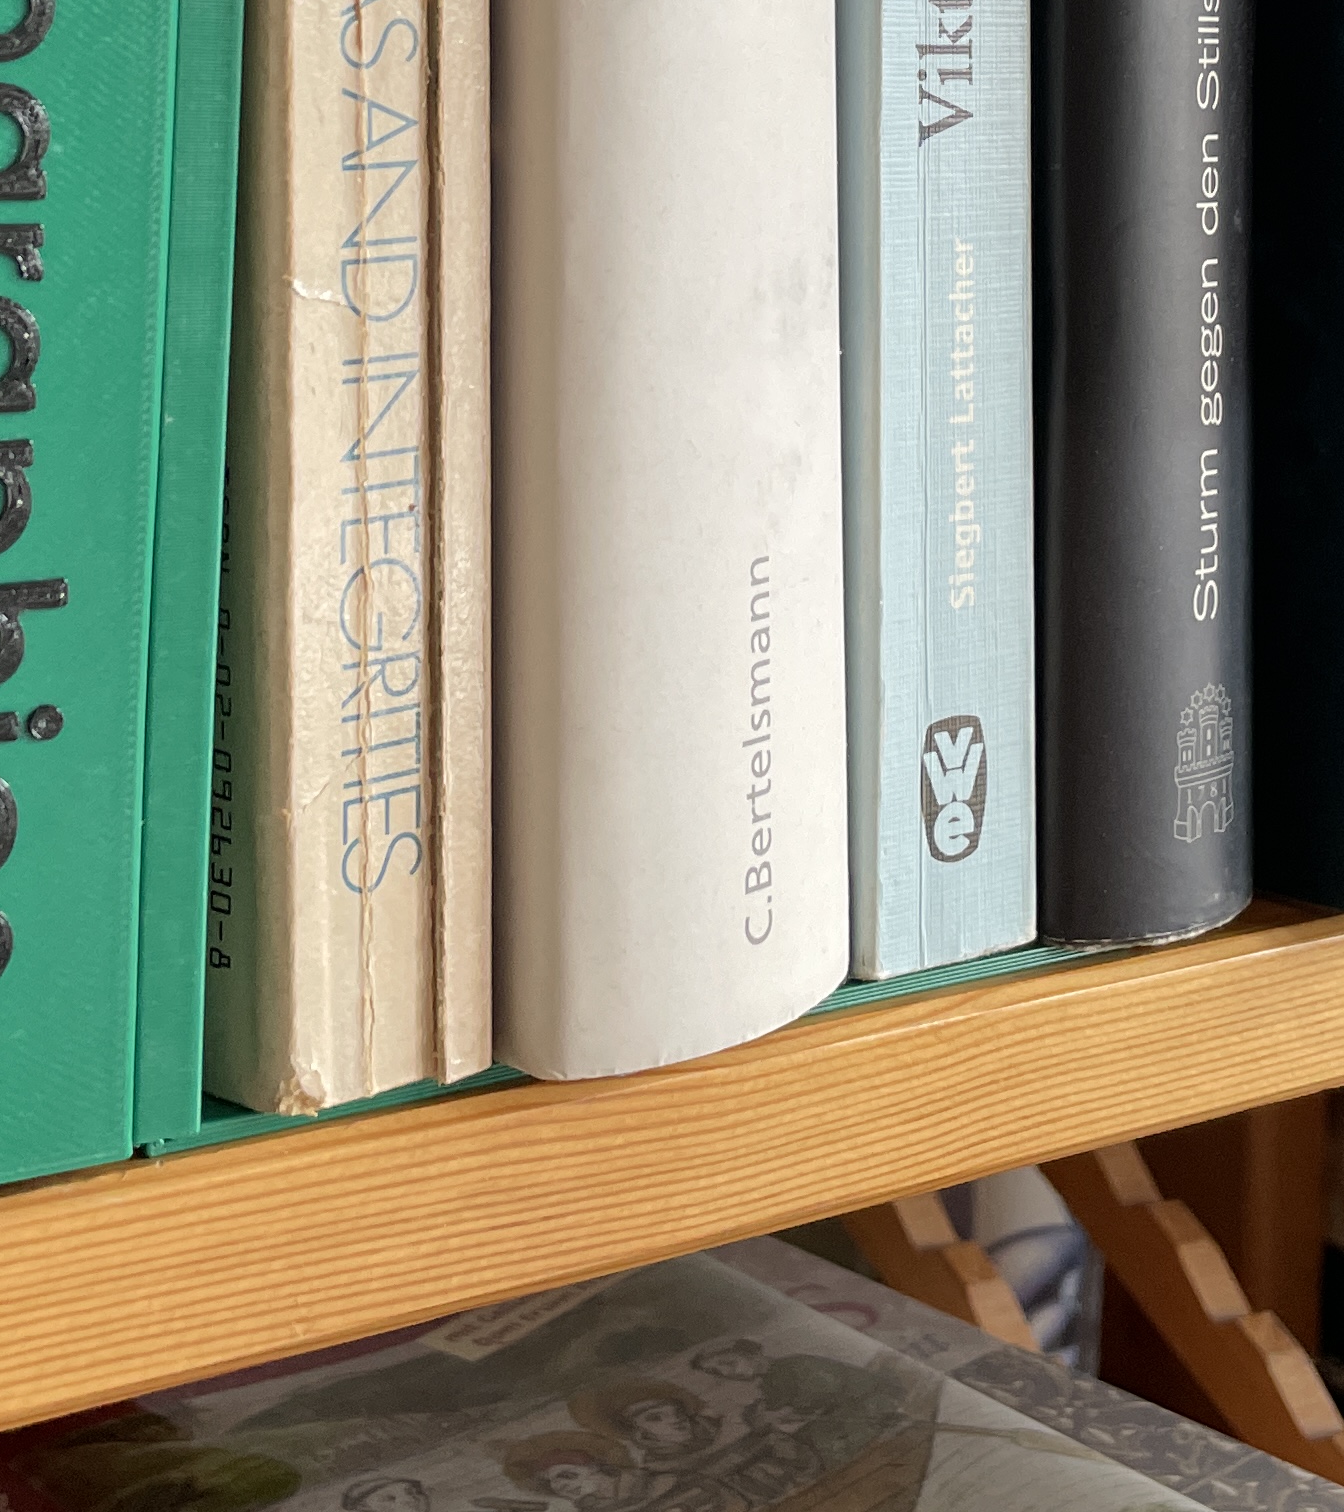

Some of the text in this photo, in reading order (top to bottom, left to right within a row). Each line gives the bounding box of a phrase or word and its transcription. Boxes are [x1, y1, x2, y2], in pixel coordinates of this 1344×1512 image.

[340, 87, 420, 324] AND
[1196, 134, 1220, 238] den
[947, 237, 981, 609] Siegbert Lattacher
[1199, 256, 1224, 427] gegen
[339, 350, 423, 896] INTEGRITIES
[1192, 448, 1221, 623] Sturm
